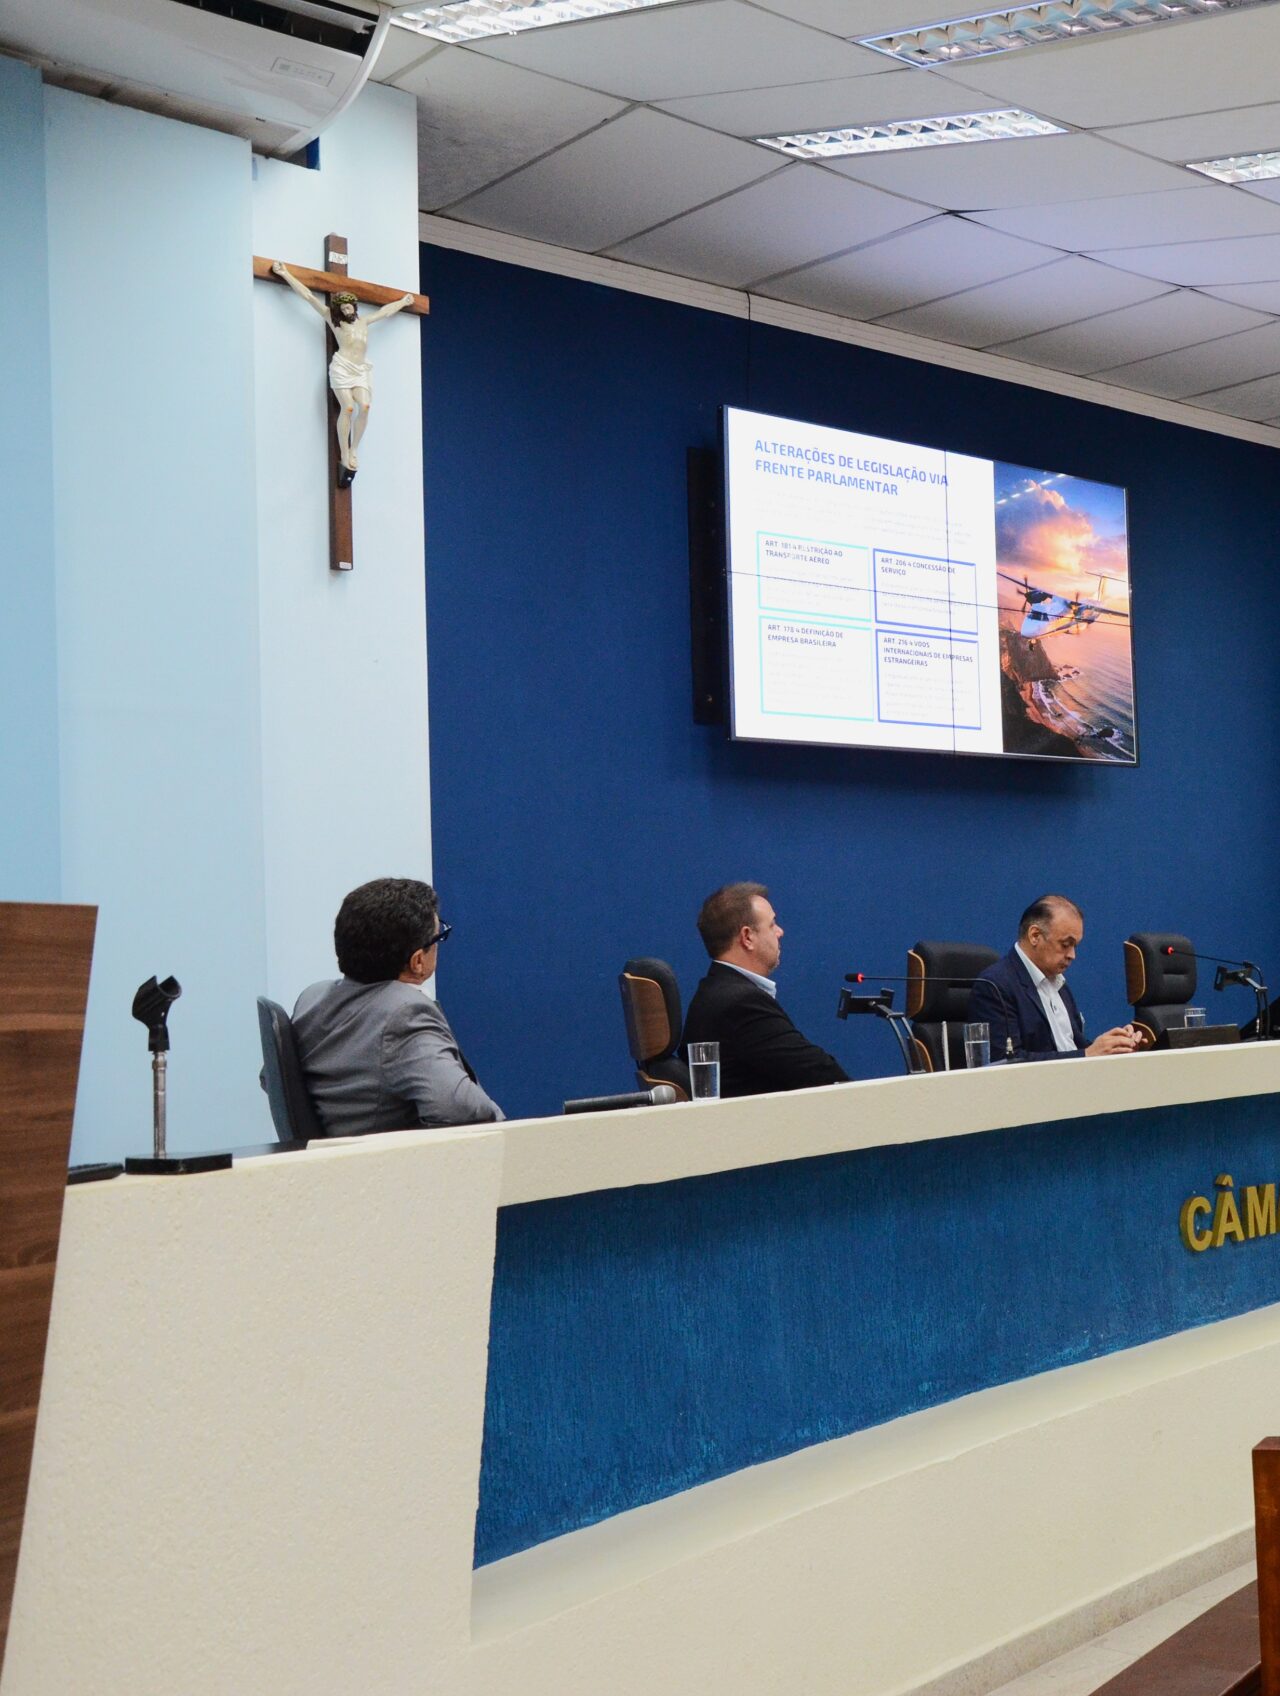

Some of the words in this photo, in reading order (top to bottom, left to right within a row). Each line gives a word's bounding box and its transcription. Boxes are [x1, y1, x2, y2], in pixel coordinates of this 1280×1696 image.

[754, 439, 836, 466] ALTERAÇÕES
[838, 455, 854, 469] DE
[856, 458, 927, 484] LEGISLAÇÃO
[929, 471, 949, 487] VIA
[755, 459, 805, 479] FRENTE
[807, 469, 899, 496] PARLAMENTAR
[767, 634, 799, 644] EMPRESA
[800, 637, 837, 647] BRASILEIRA
